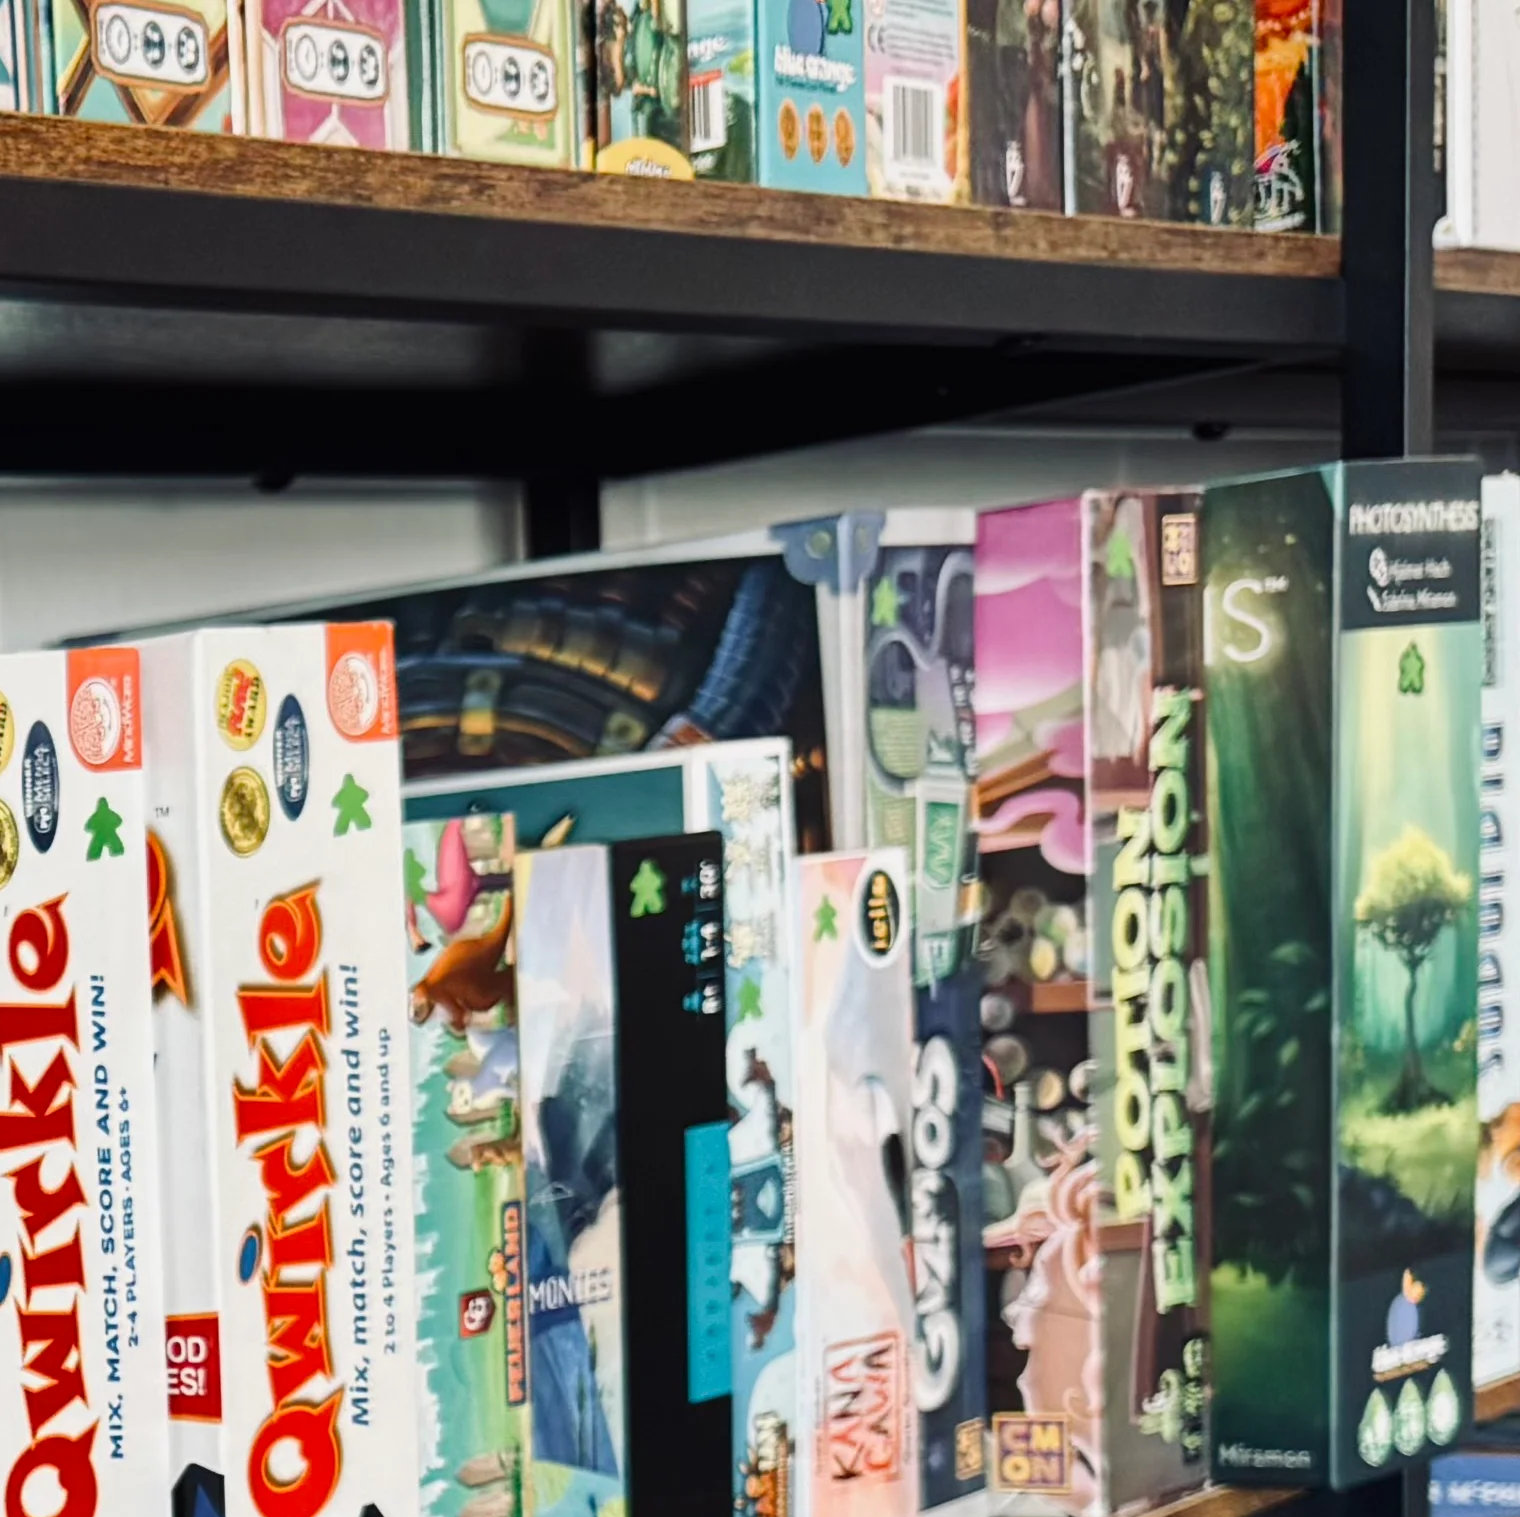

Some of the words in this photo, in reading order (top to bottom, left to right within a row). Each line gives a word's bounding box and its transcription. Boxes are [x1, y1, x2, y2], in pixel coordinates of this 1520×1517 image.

[1349, 500, 1478, 535] PHOTOSYNTHESIS
[89, 973, 108, 1053] WIN!
[340, 964, 360, 1038] win!
[1113, 806, 1151, 1222] POTION
[379, 1029, 390, 1053] up
[95, 1063, 111, 1129] AND
[340, 1049, 361, 1118] and
[378, 1063, 390, 1102] and
[379, 1113, 390, 1124] 6
[119, 1125, 132, 1183] AGES
[349, 1129, 364, 1215] score
[379, 1133, 393, 1185] Ages
[98, 1141, 115, 1254] SCORE
[121, 1206, 137, 1301] PLAYERS
[382, 1211, 395, 1288] Players
[347, 1229, 368, 1345] match,
[383, 1294, 394, 1306] 4
[102, 1272, 121, 1377] MATCH,
[127, 1313, 139, 1348] 2-4
[384, 1313, 394, 1335] to
[384, 1340, 395, 1354] 2
[350, 1358, 370, 1426] Mix,
[109, 1395, 125, 1459] MIX,
